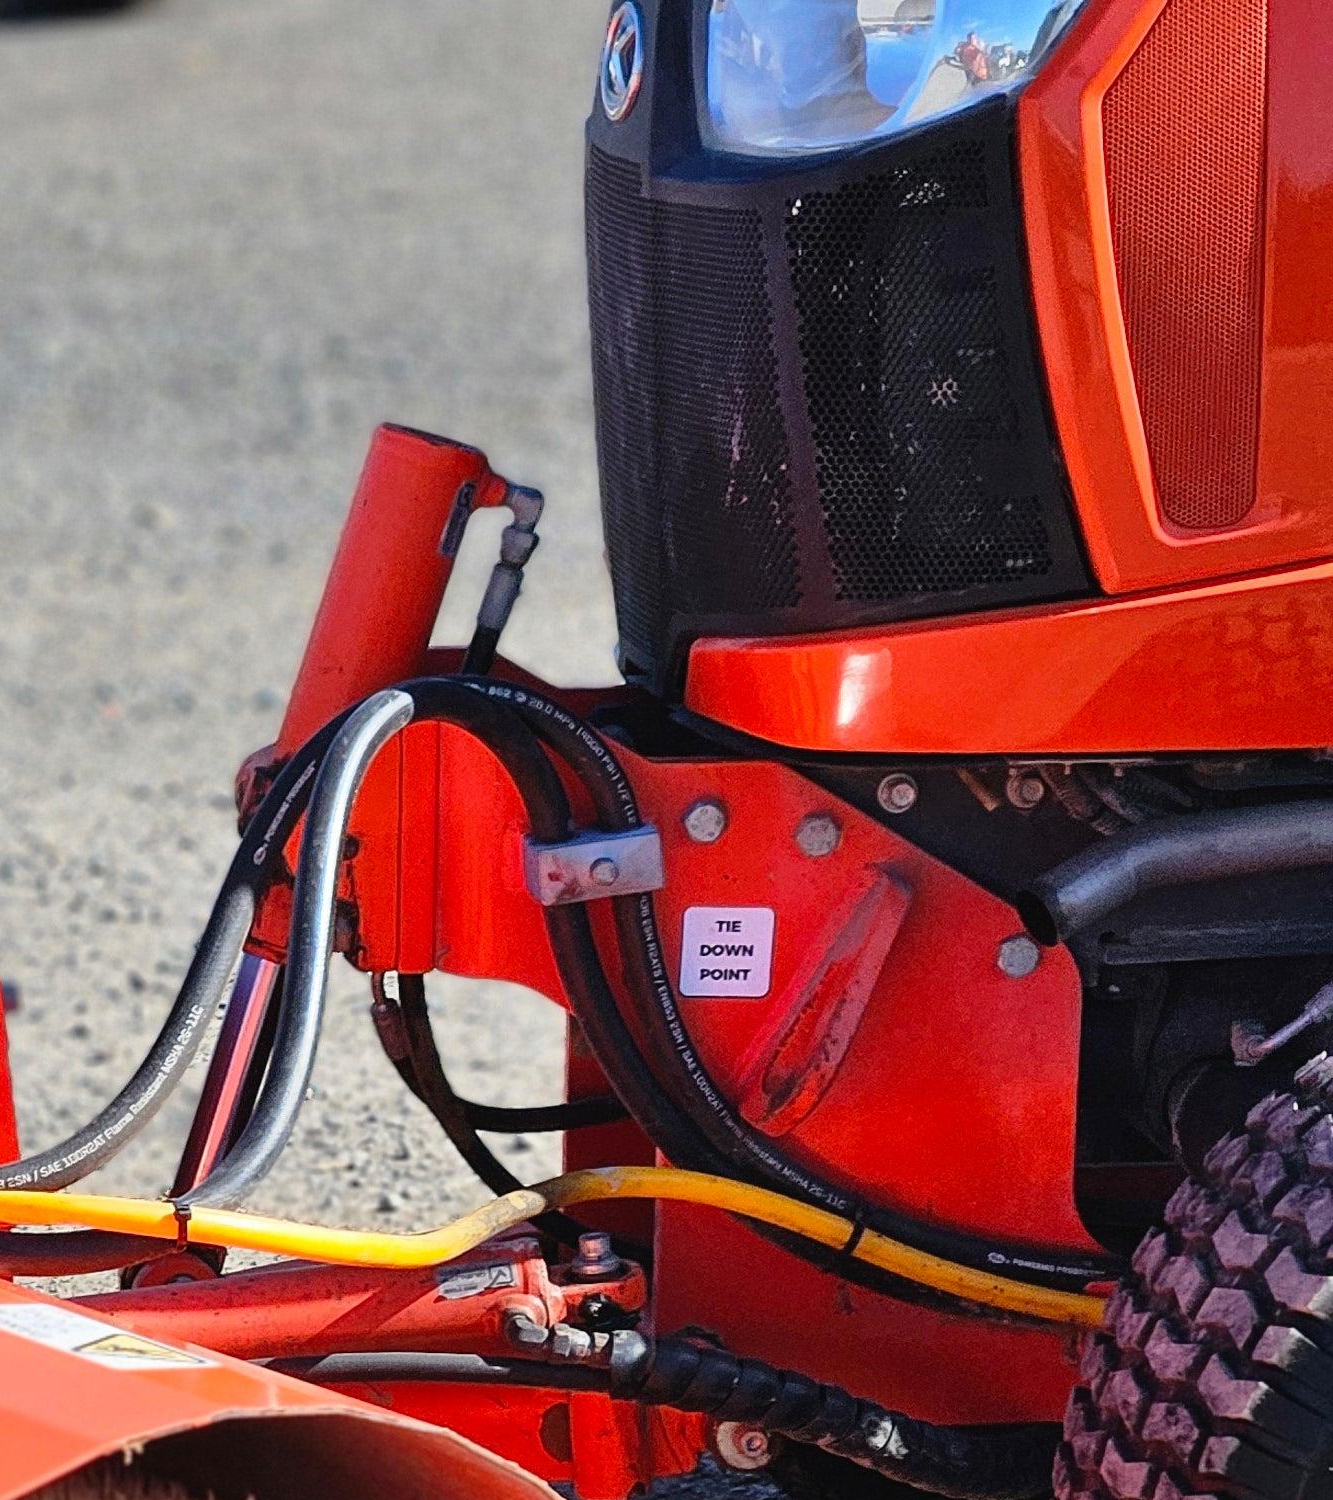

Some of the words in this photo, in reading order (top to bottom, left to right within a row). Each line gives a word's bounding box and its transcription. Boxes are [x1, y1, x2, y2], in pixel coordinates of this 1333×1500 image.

[715, 920, 743, 933] TIE
[699, 944, 755, 957] DOWN
[699, 968, 752, 981] POINT
[7, 1173, 32, 1188] 2SN
[39, 1161, 64, 1178] SAE
[62, 1134, 106, 1167] 100R2AT
[103, 1112, 134, 1140] Flame
[129, 1072, 168, 1115] Resistant
